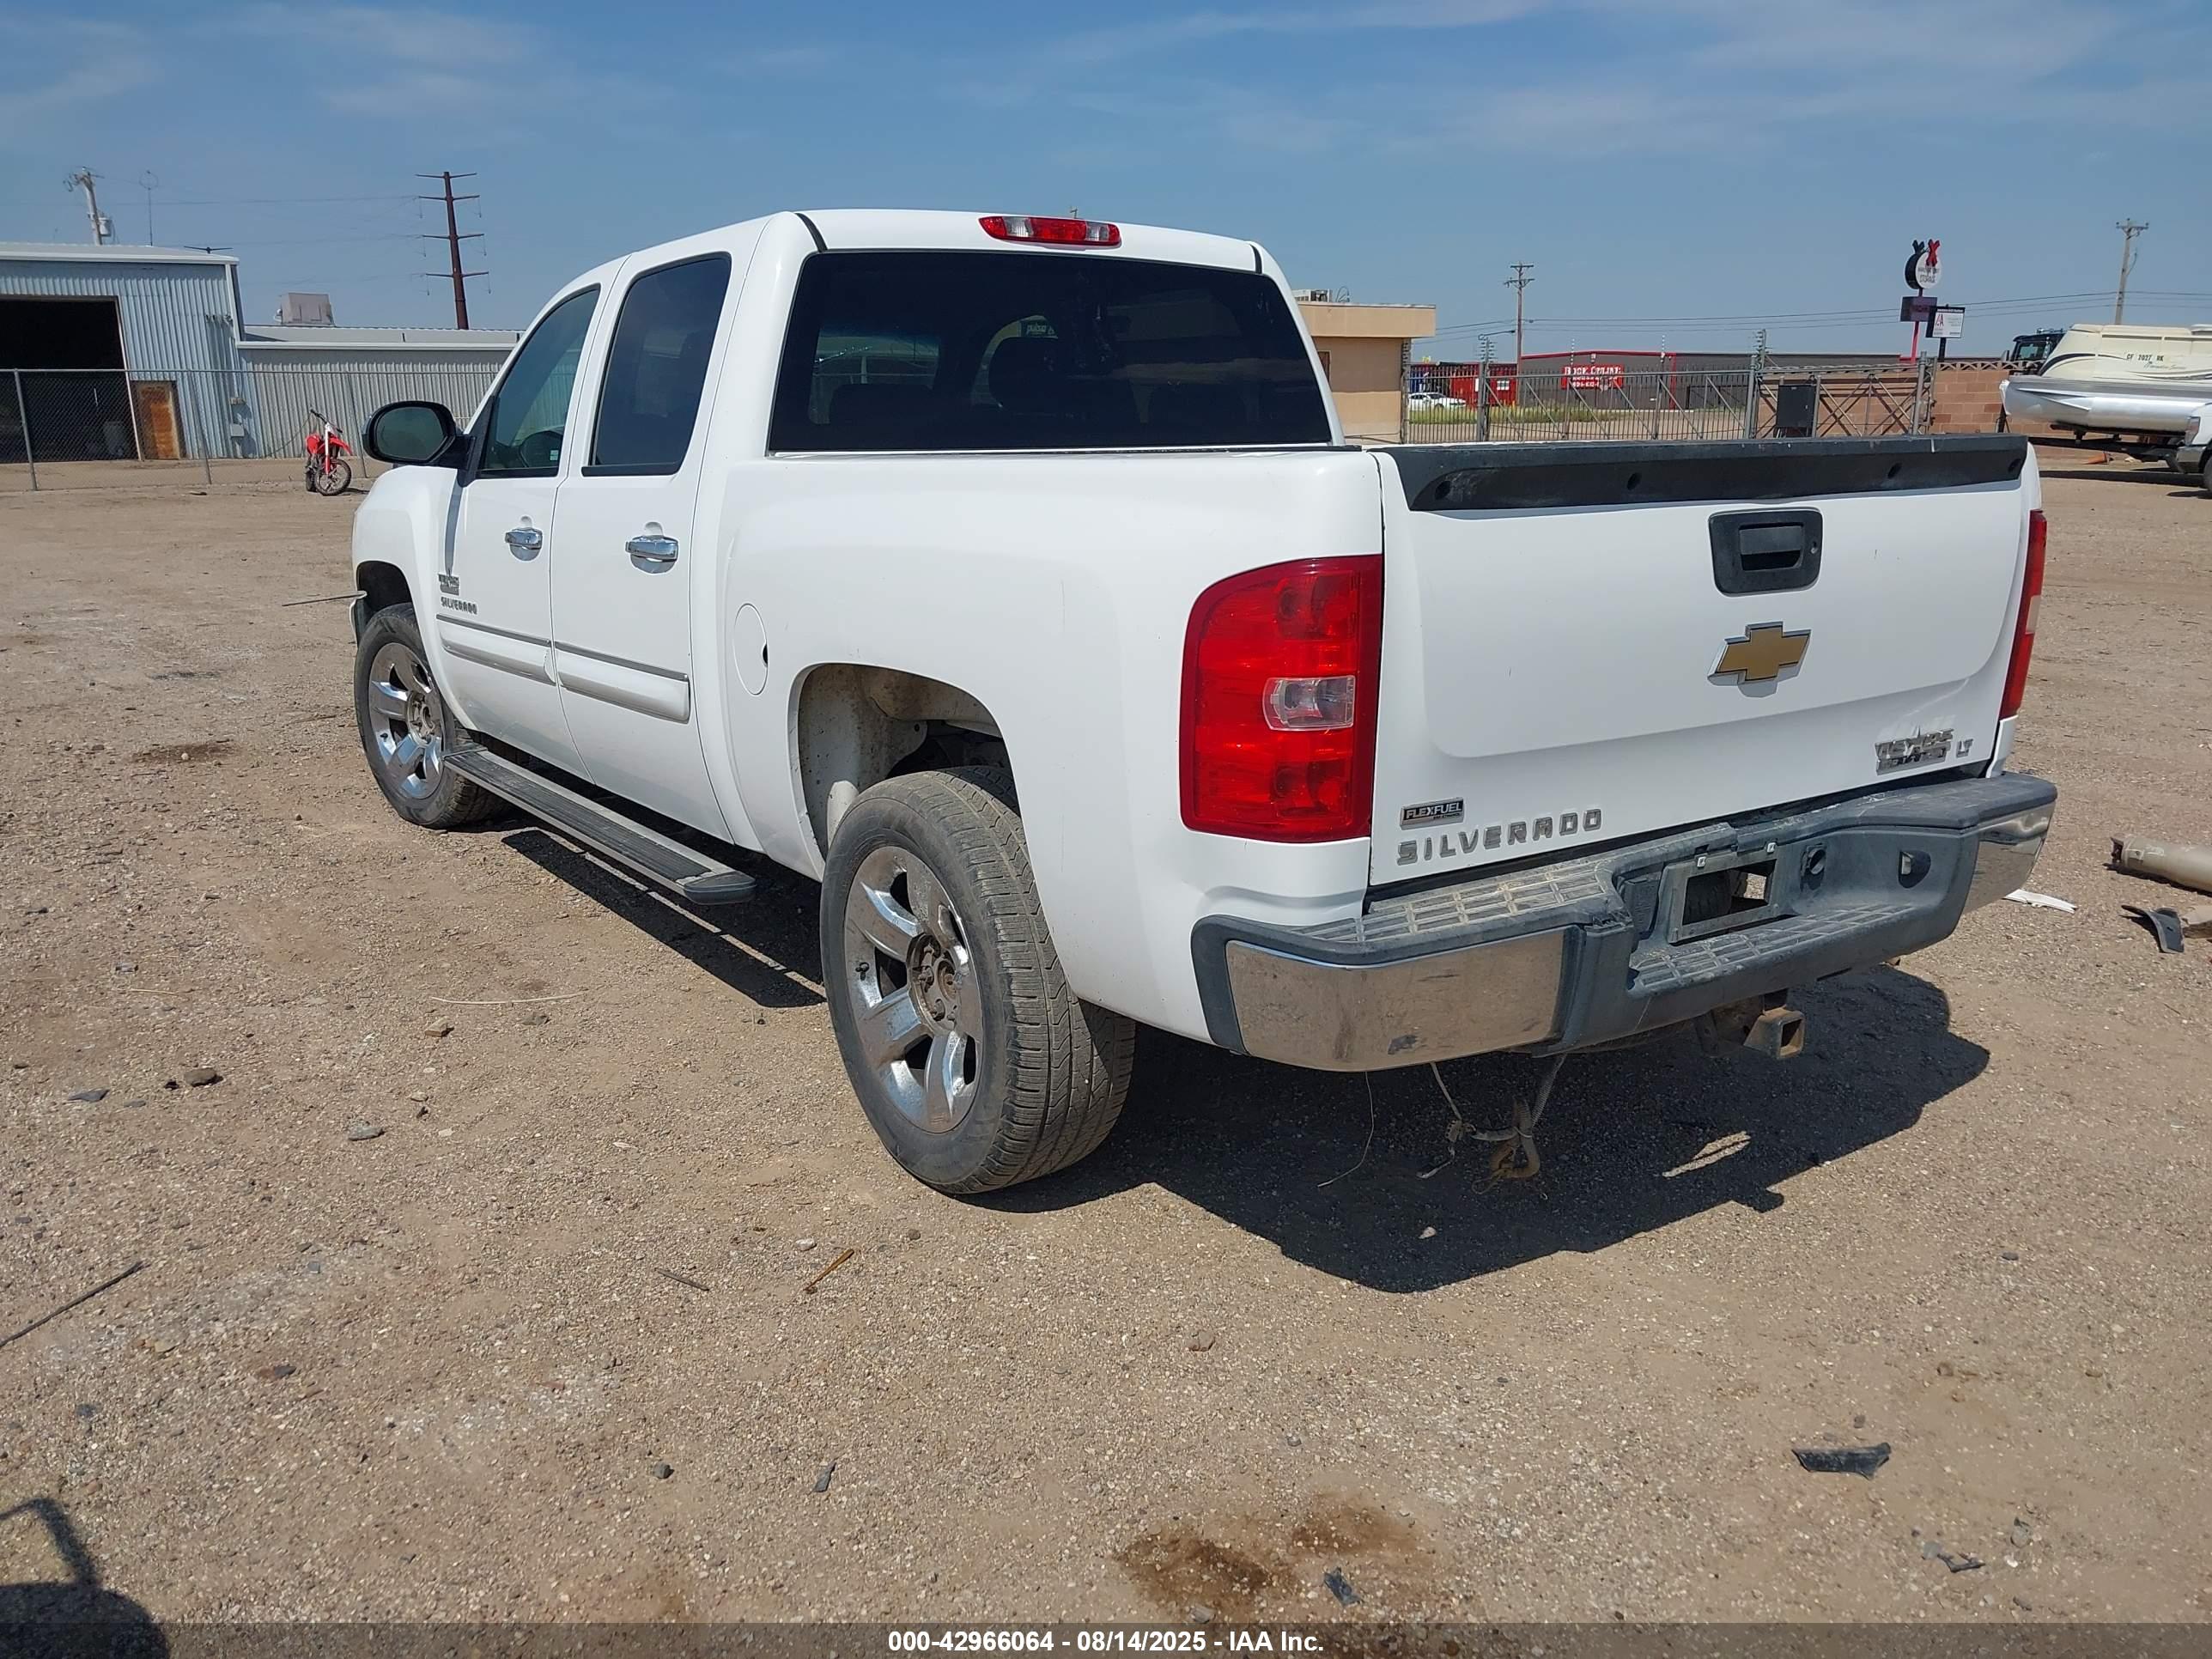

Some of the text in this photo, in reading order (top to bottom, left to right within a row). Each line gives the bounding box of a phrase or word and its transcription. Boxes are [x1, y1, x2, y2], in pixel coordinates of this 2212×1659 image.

[441, 596, 477, 615] SILVERADO
[1955, 738, 1974, 757] LT
[1406, 802, 1462, 820] FLEXFUEL
[1396, 808, 1602, 866] SILVERADO
